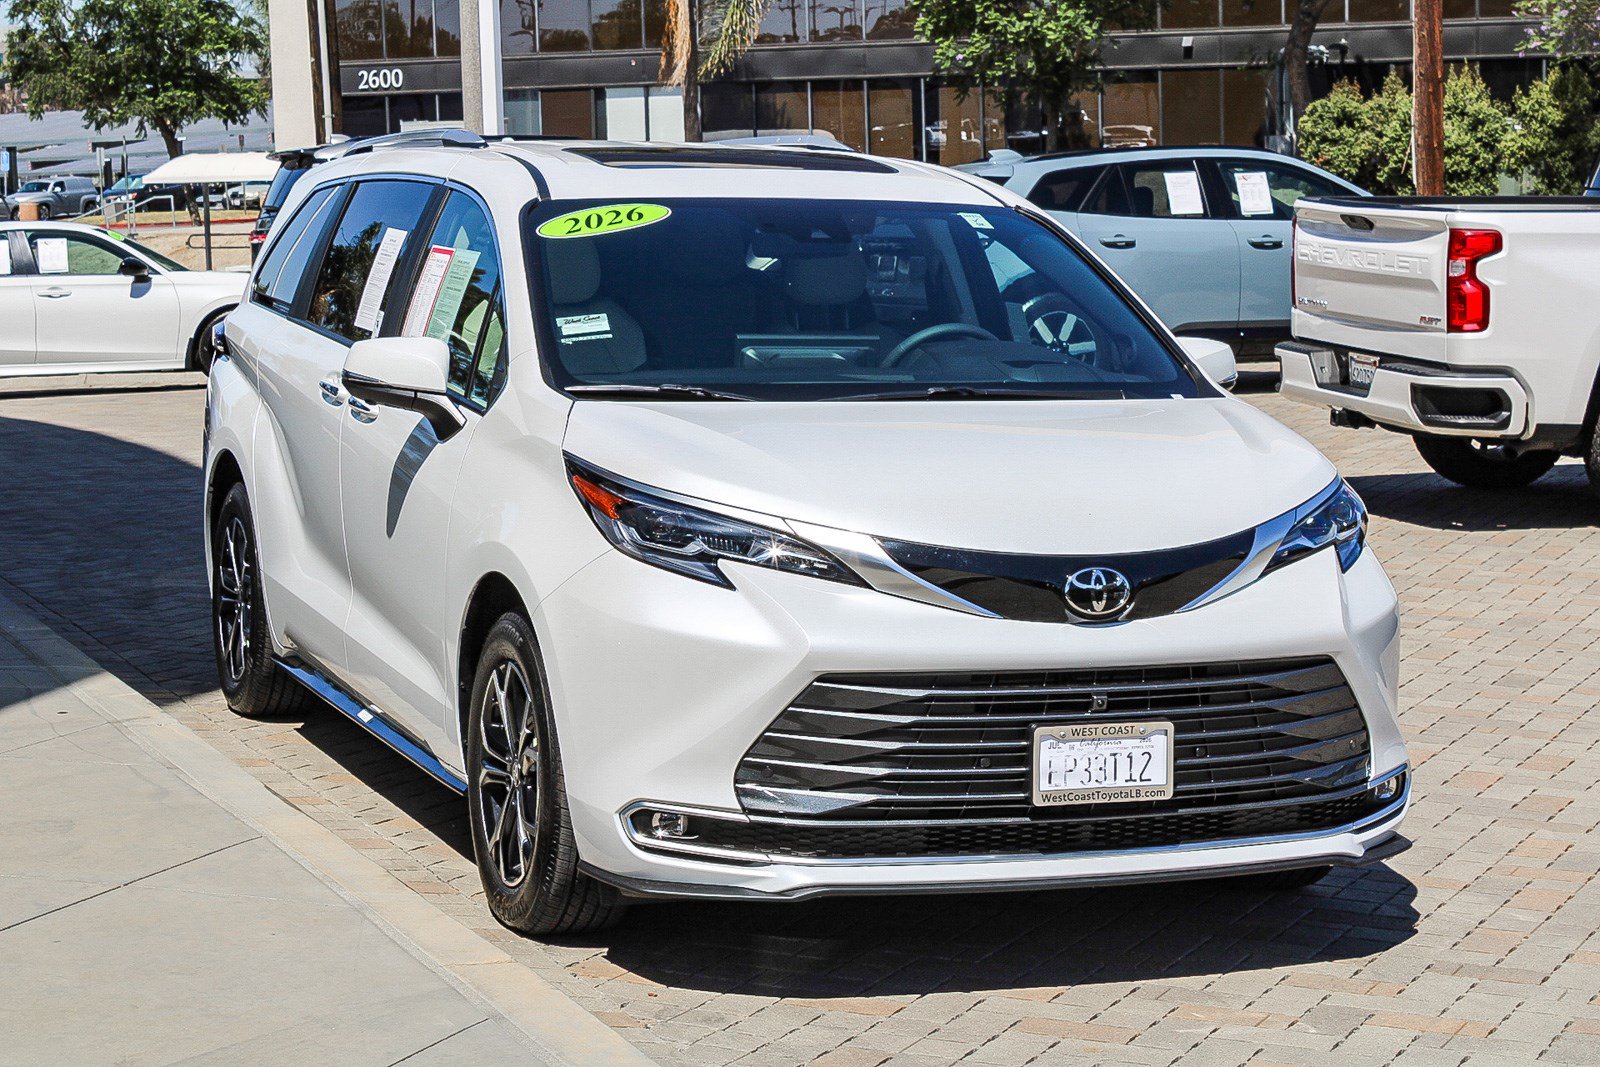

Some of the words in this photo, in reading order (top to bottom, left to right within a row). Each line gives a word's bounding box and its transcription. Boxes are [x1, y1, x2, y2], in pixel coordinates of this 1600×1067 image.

[358, 68, 403, 89] 2600
[564, 206, 644, 235] 2026
[1297, 242, 1429, 274] CHEVROLET
[1071, 727, 1099, 737] WEST
[1101, 725, 1135, 736] COAST
[1041, 789, 1166, 803] WestCoastToyotaLB.com
